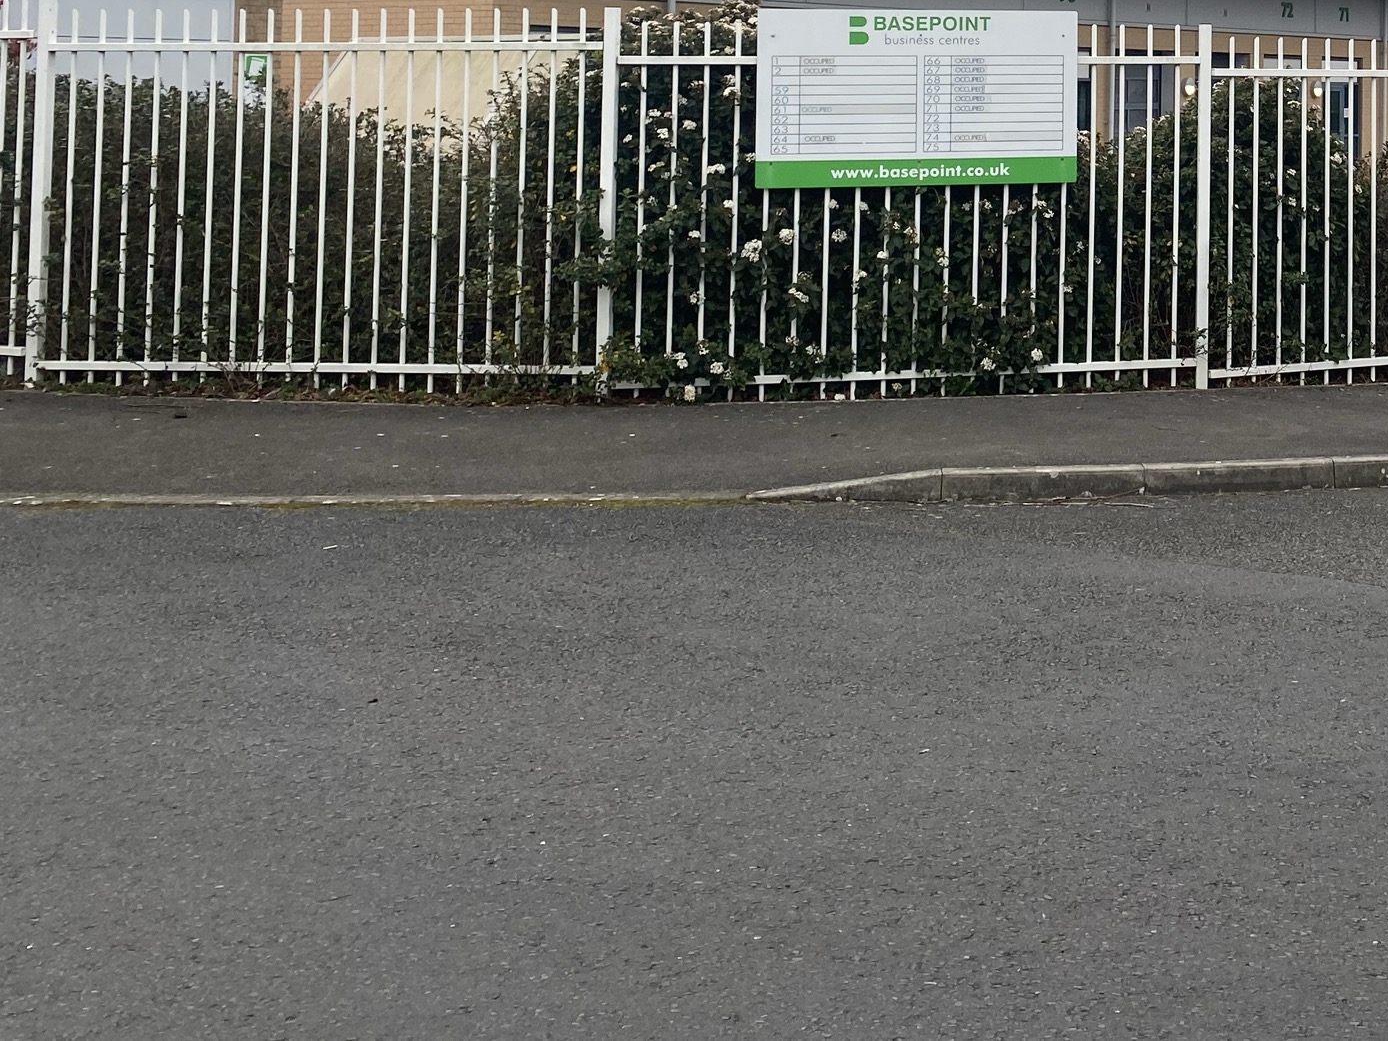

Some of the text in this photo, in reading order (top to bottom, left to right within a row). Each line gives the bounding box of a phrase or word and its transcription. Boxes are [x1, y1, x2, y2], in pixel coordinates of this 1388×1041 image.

[1281, 2, 1294, 18] 72
[1338, 7, 1349, 22] 71
[874, 16, 991, 31] BASEPOINT
[884, 34, 980, 45] business centres
[926, 56, 941, 65] 66
[774, 66, 782, 76] 2
[926, 66, 941, 75] 67
[926, 75, 941, 84] 68
[774, 86, 790, 96] 59
[926, 85, 941, 94] 69
[773, 96, 789, 106] 60
[926, 95, 940, 104] 70
[773, 106, 787, 115] 61
[926, 104, 938, 113] 71
[773, 115, 789, 125] 62
[926, 114, 940, 123] 72
[773, 125, 789, 135] 63
[926, 123, 940, 132] 73
[773, 135, 788, 145] 64
[926, 133, 940, 142] 74
[773, 145, 789, 154] 65
[926, 143, 940, 152] 75
[830, 162, 1010, 181] www.basepoint.co.uk
